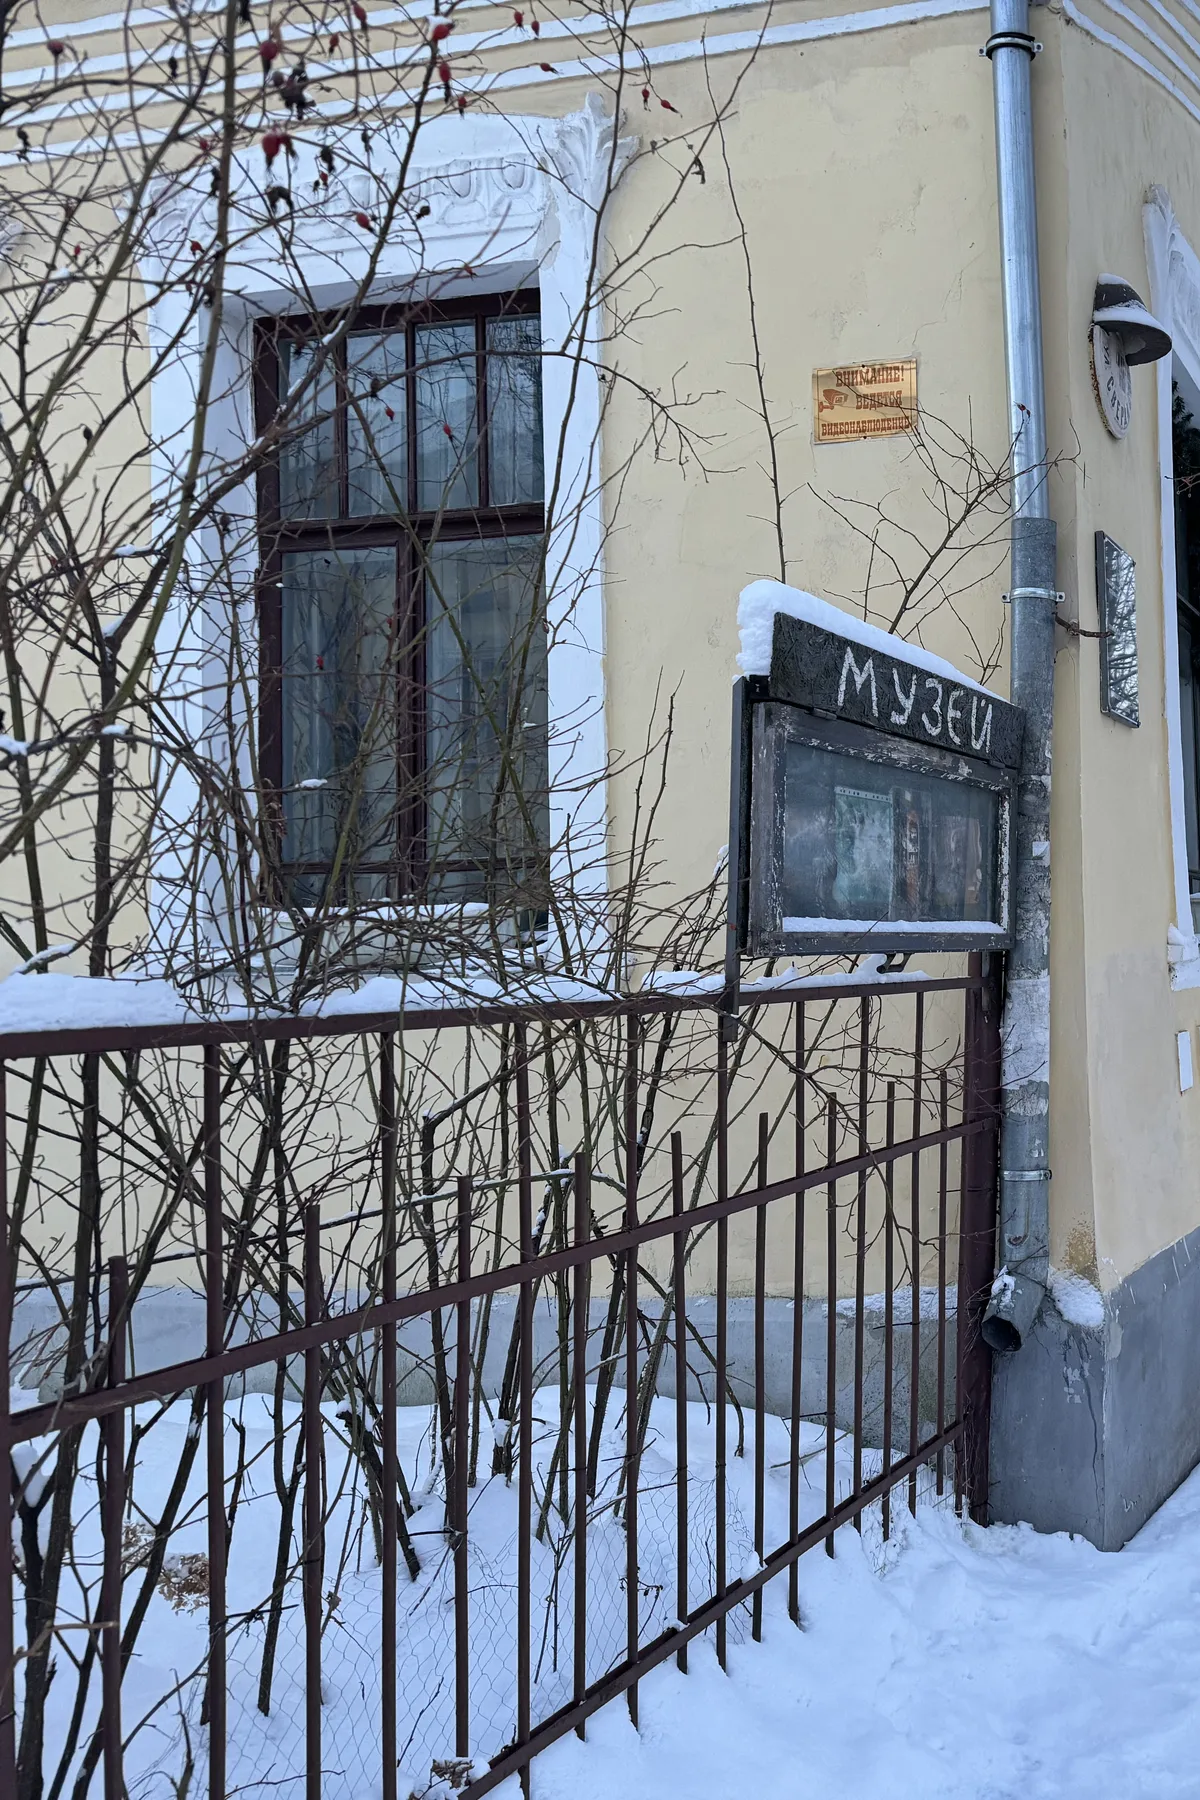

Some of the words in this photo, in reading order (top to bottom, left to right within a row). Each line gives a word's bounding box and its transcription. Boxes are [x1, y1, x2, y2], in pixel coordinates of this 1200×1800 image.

[835, 365, 904, 387] ВНИМАНИЕ!
[856, 390, 902, 410] ВЕДЕТСЯ
[821, 416, 910, 436] ВИДЕОНАБЛЮДЕНИЕ
[838, 647, 993, 753] МУЗЕЙ
